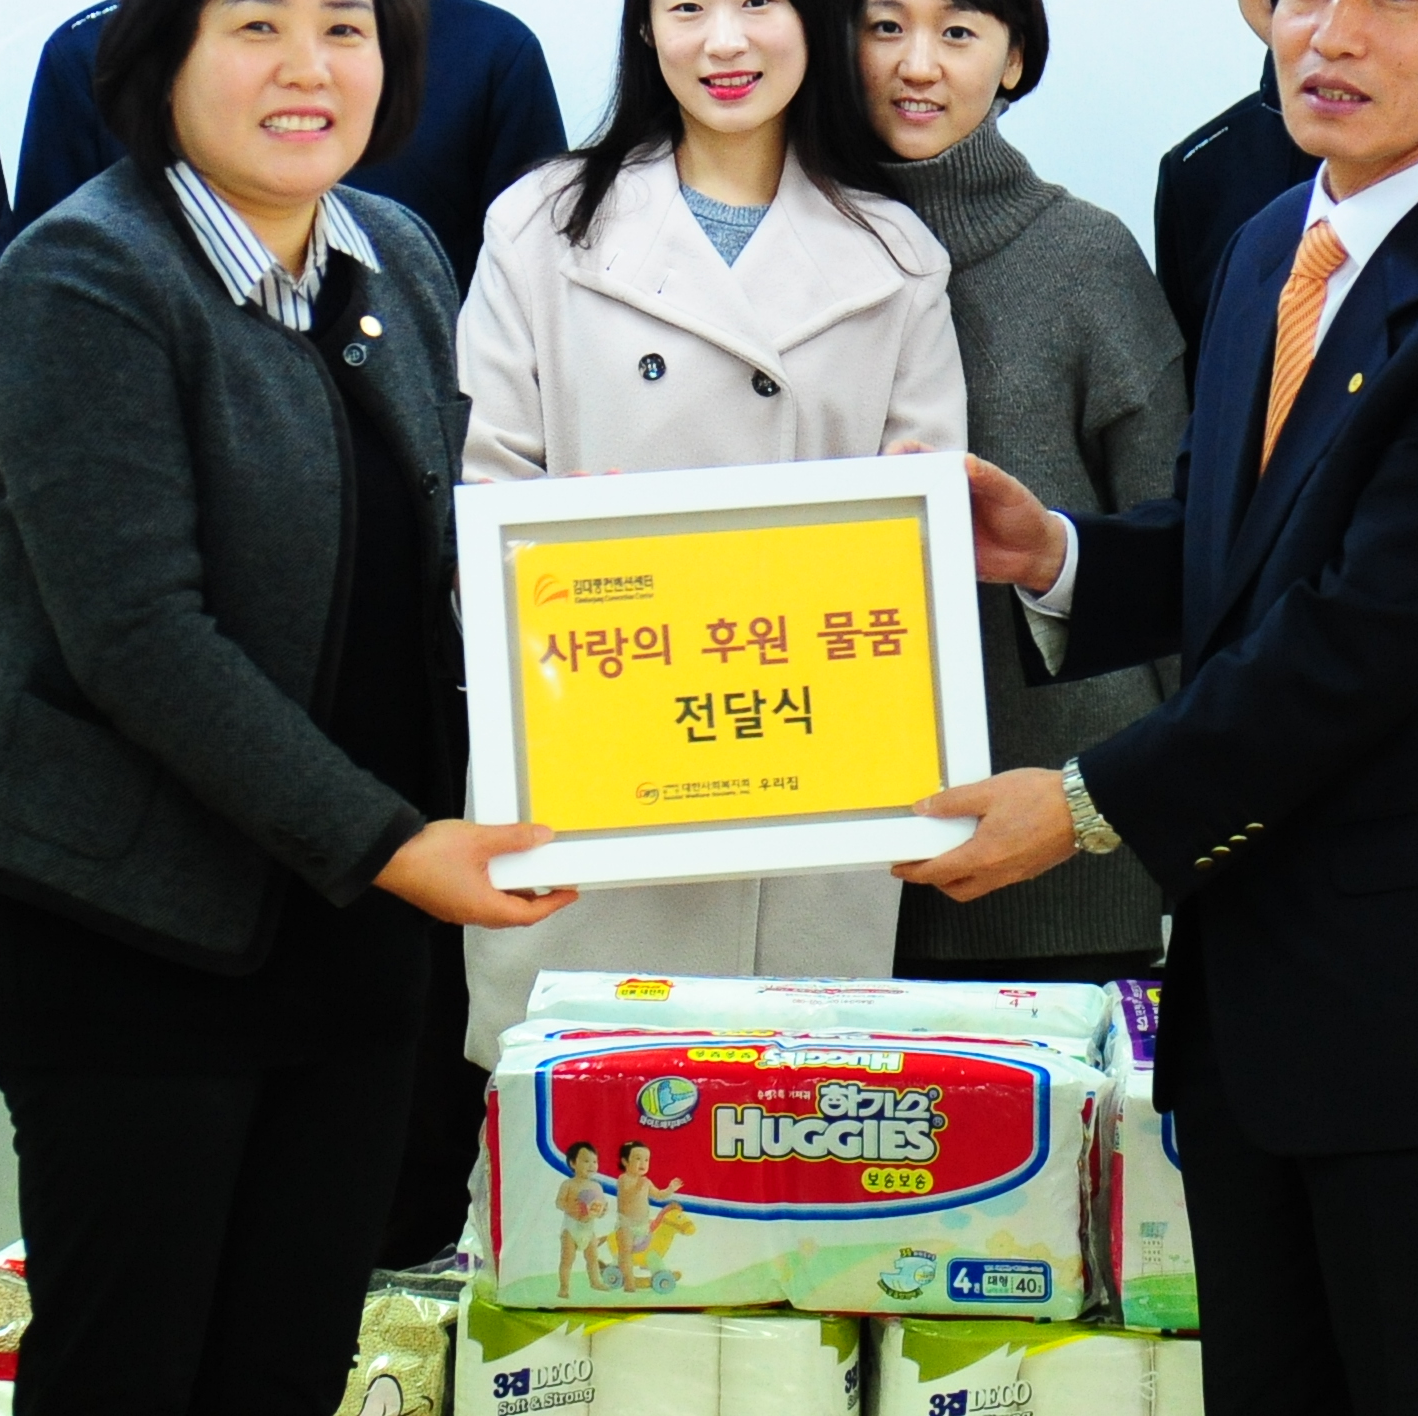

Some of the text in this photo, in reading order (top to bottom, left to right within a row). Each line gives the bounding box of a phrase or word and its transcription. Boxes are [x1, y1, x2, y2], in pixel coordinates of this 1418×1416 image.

[573, 574, 653, 594] 김대중컨벤션센터
[539, 608, 908, 679] 사랑의 후원 물품
[674, 686, 814, 743] 전달식
[759, 776, 799, 791] 우리집
[819, 1084, 931, 1119] 하기스
[715, 1106, 937, 1161] HUGGIES
[867, 1172, 927, 1189] 보송보송
[952, 1266, 973, 1295] 4
[987, 1274, 1009, 1288] 대형
[1015, 1277, 1037, 1294] 40
[493, 1358, 593, 1399] 3겹 DECO
[498, 1387, 596, 1416] Soft & Strong
[969, 1380, 1032, 1412] DECO
